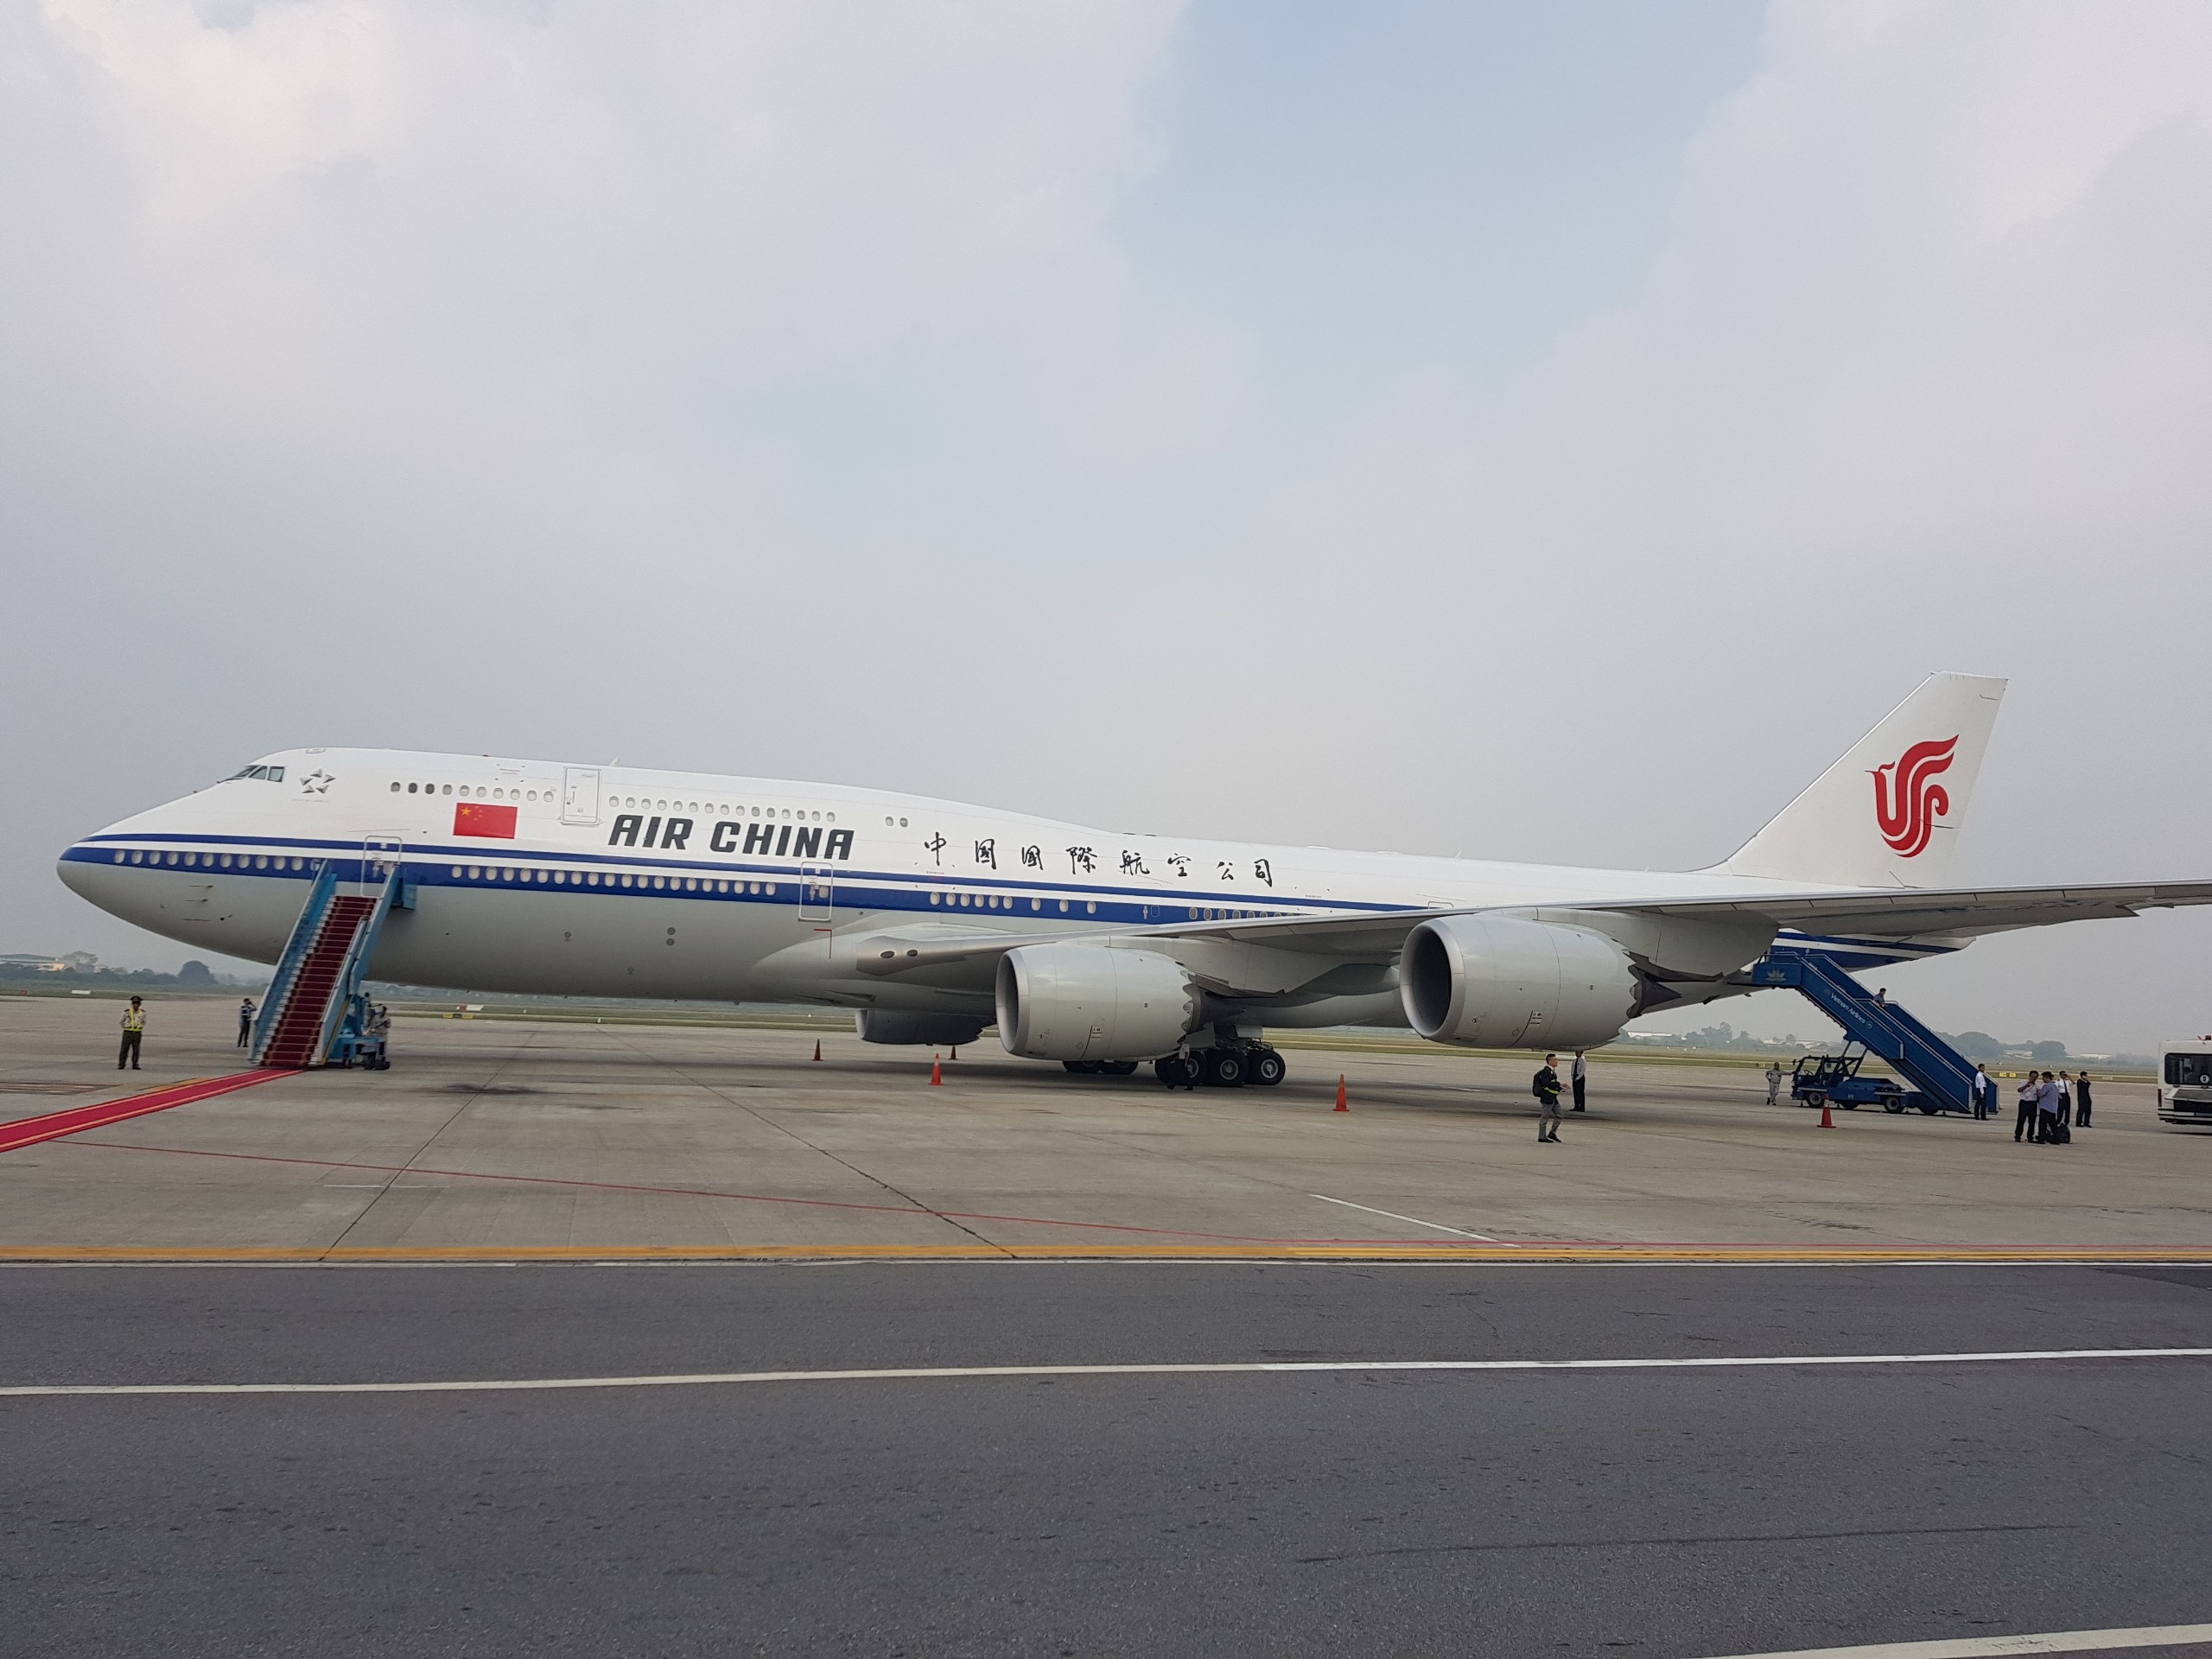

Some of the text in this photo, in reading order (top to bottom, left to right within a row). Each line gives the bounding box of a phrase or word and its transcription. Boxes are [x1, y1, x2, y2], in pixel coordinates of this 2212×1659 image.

[607, 814, 855, 861] AIR CHINA
[1831, 992, 1866, 1024] Vietnam Airlines
